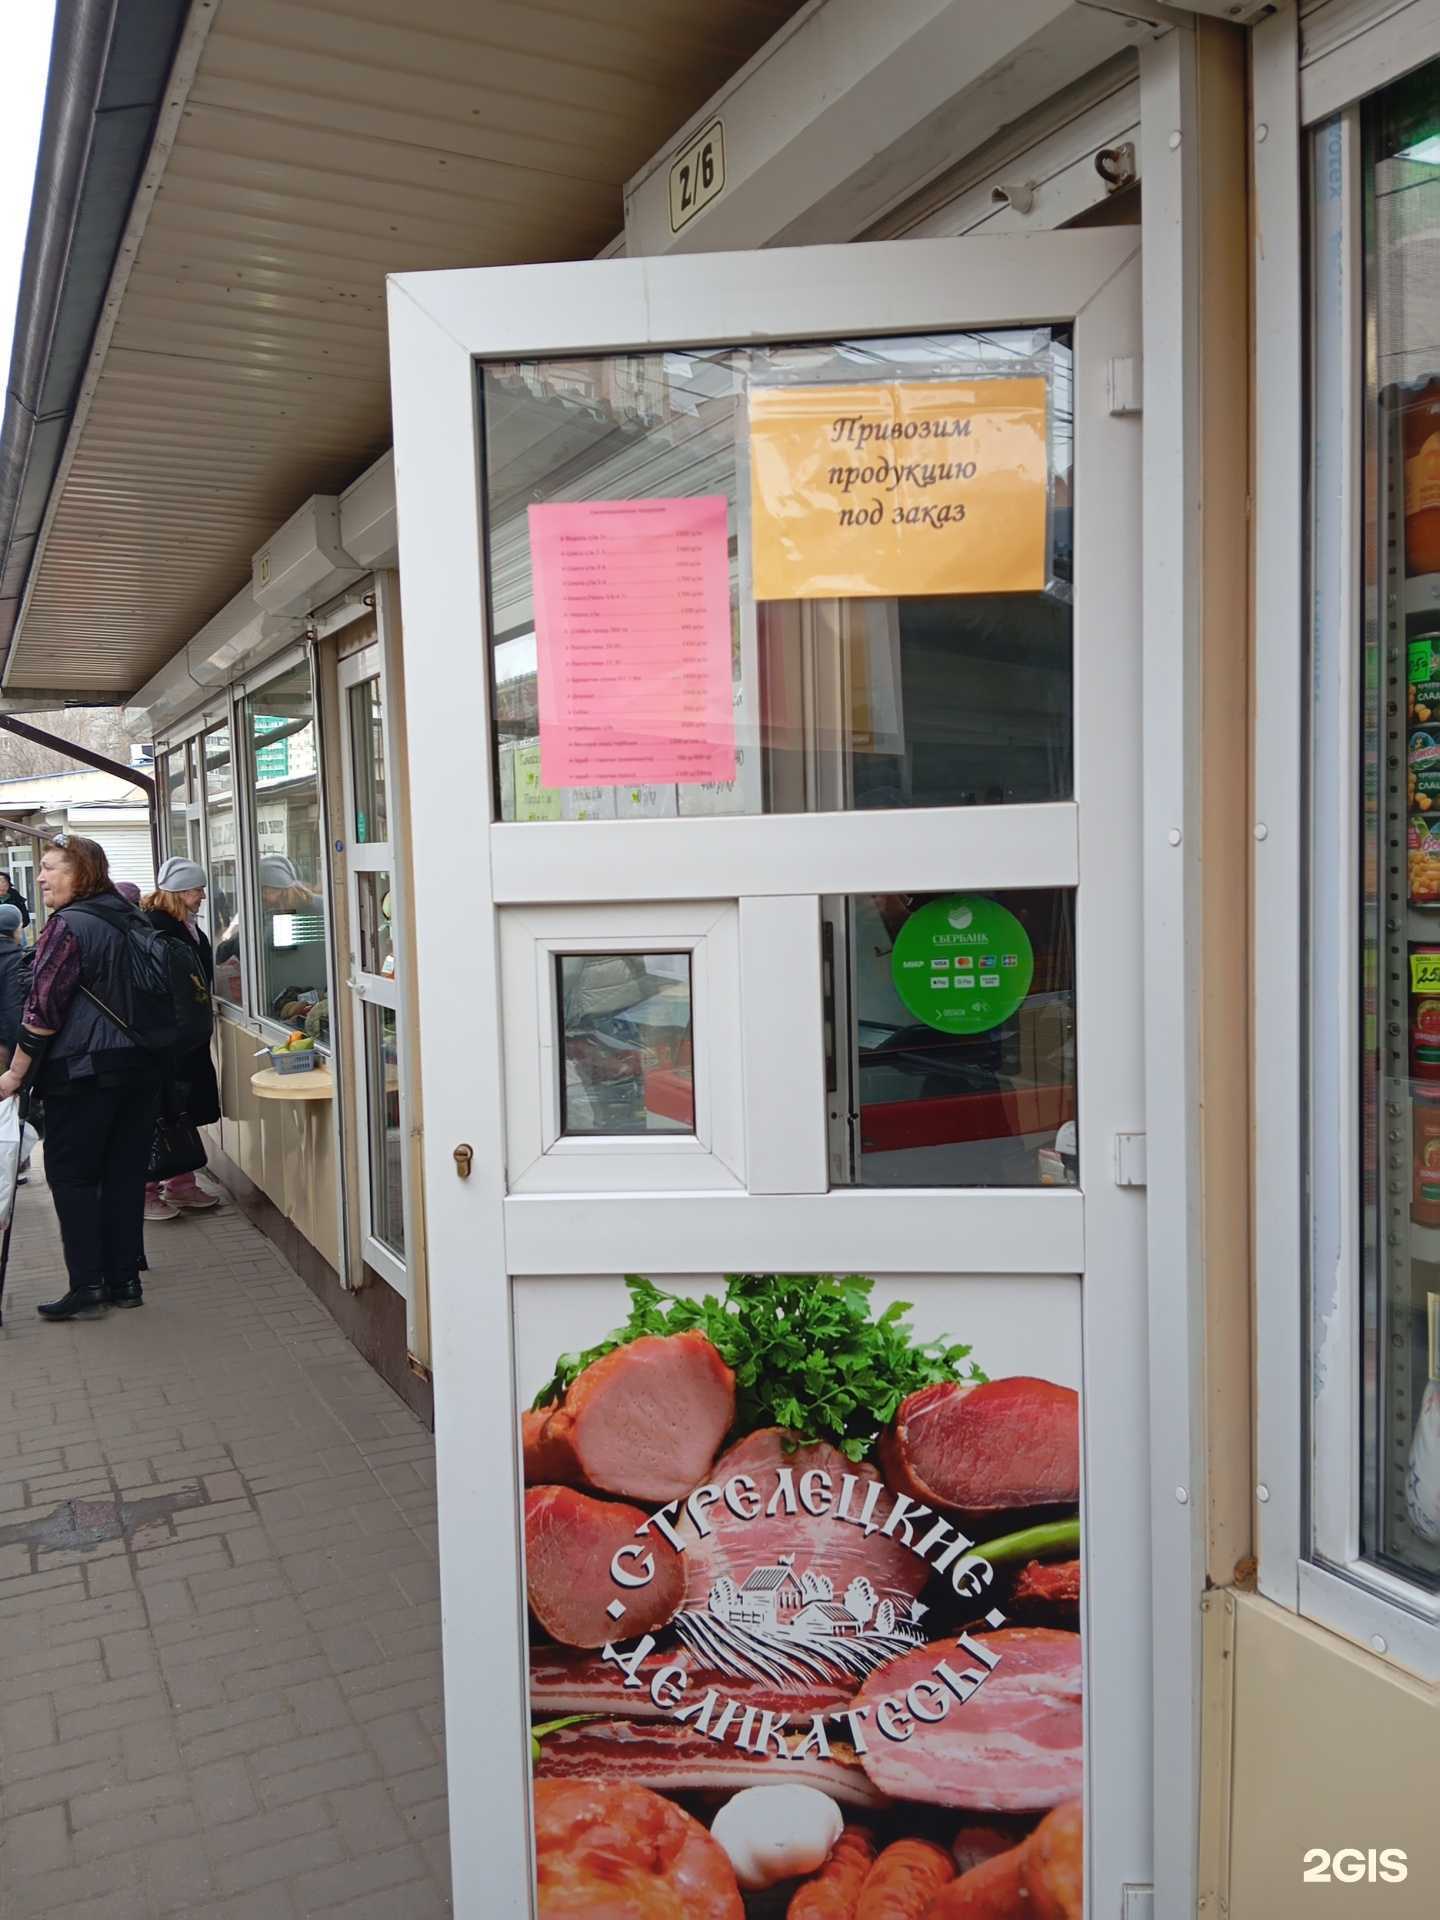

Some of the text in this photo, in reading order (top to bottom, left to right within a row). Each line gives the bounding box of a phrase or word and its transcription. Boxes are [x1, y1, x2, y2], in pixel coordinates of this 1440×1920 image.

[680, 142, 714, 211] 2/6
[831, 415, 971, 450] Привозим
[828, 456, 977, 492] продукцию
[839, 498, 967, 529] под заказ
[933, 933, 990, 945] СБЕРБАНК
[609, 1468, 994, 1599] СТРЕЛЕЦКИЕ
[601, 1630, 1002, 1761] ДЕЛИКАТЕСЫ
